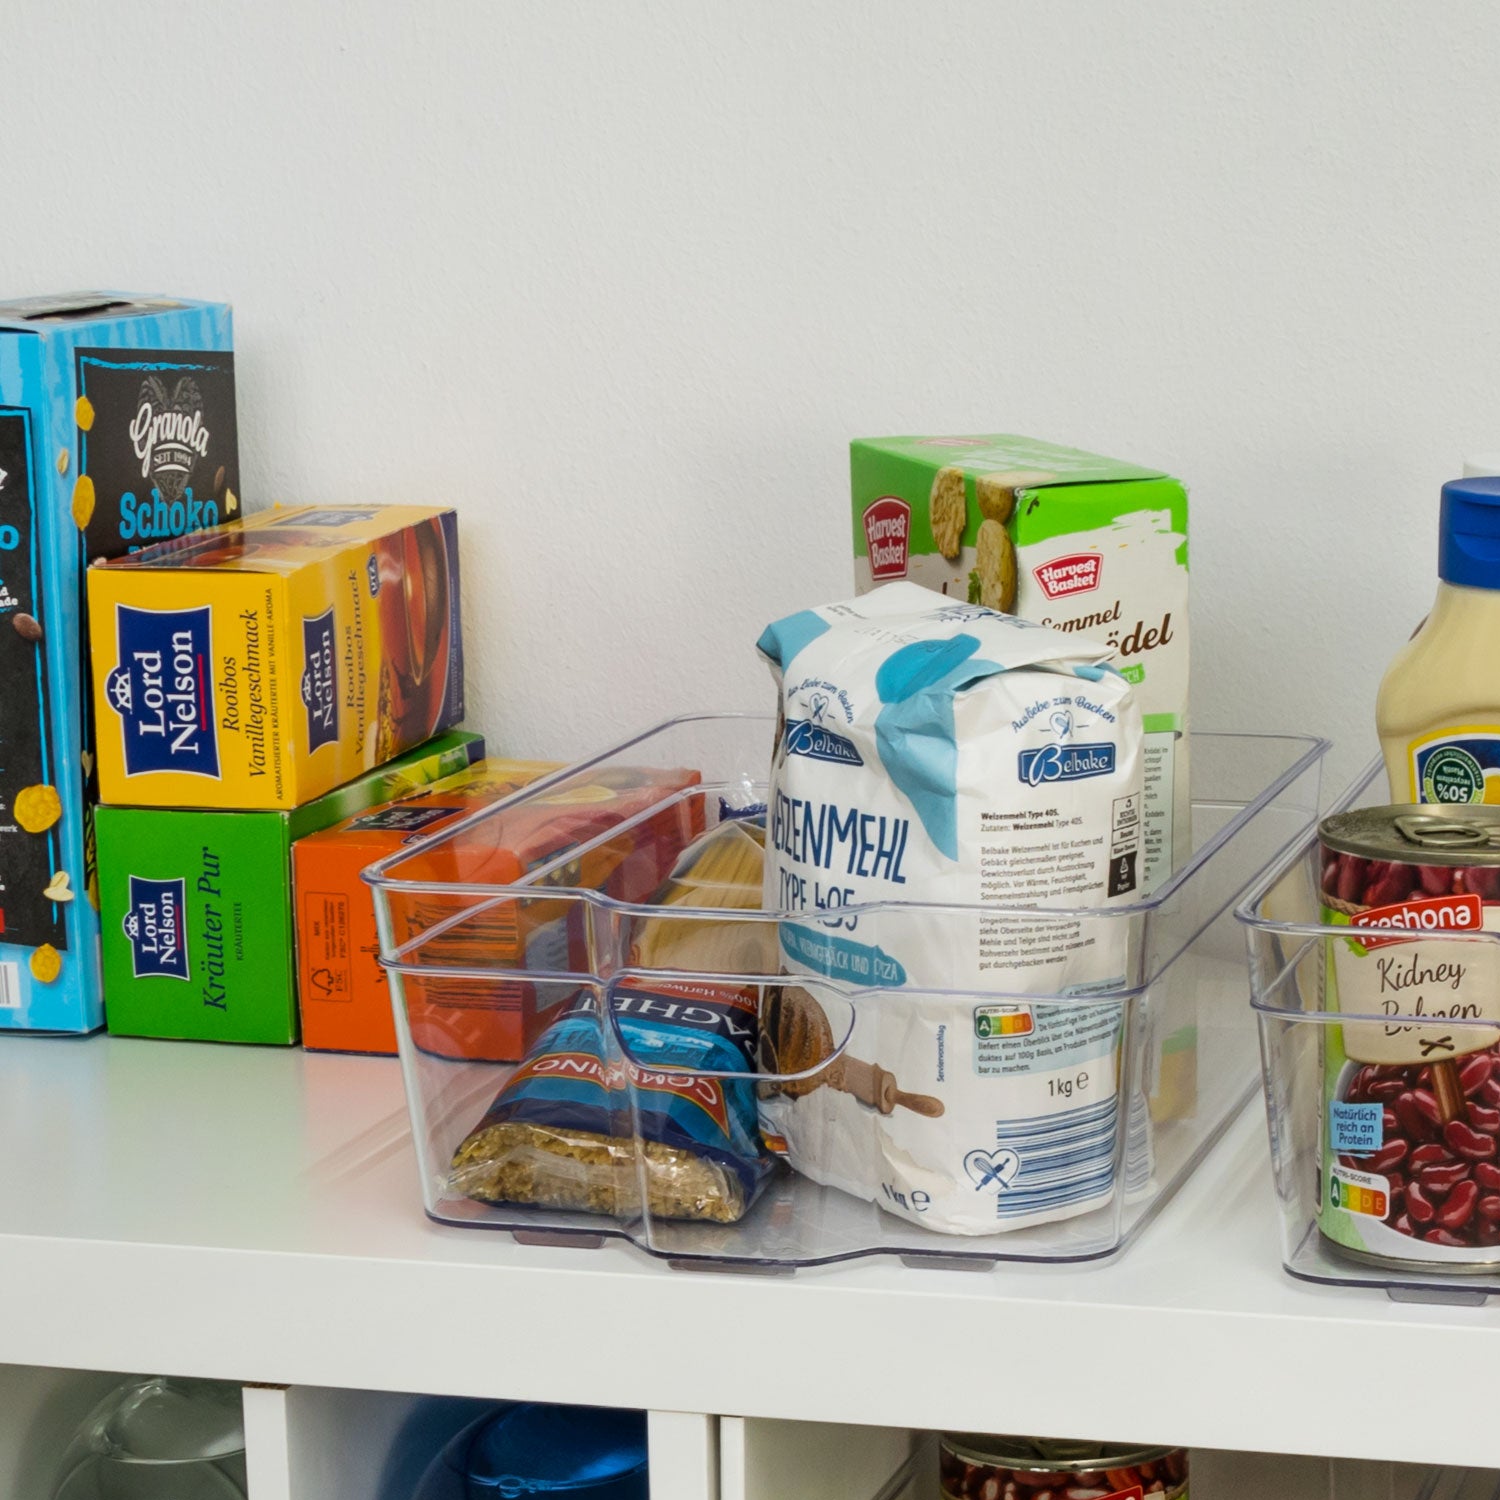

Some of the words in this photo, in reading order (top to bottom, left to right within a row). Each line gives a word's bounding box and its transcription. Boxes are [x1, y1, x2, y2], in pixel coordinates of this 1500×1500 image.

[129, 402, 209, 478] Granola
[154, 451, 171, 466] SEIT
[173, 450, 193, 468] 1994
[119, 488, 219, 540] Schoko
[868, 513, 906, 540] Harvest
[871, 542, 905, 567] Basket
[1042, 558, 1097, 582] Harvest
[1048, 573, 1096, 595] Basket
[264, 588, 277, 659] VANILLE-AROMA
[269, 660, 278, 676] MIT
[310, 650, 323, 721] Lord
[321, 629, 335, 731] Nelson
[344, 624, 357, 709] Rooibos
[348, 569, 366, 756] Vanillegeschmack
[139, 650, 165, 737] Lord
[170, 629, 200, 756] Nelson
[219, 656, 241, 733] Rooibos
[239, 608, 267, 778] Vanillegeschmack
[1052, 696, 1073, 706] zum
[1074, 695, 1117, 724] Backen
[1028, 742, 1109, 788] Belbake
[980, 811, 1027, 822] Weizenmehl
[1027, 809, 1044, 820] Type
[1436, 782, 1468, 803] 50%
[771, 787, 909, 885] EIZENMEHL
[1012, 821, 1055, 832] Weizenmehl
[1055, 818, 1070, 828] Type
[197, 845, 222, 898] Pur
[142, 902, 158, 955] Lord
[159, 890, 177, 965] Nelson
[979, 937, 1002, 948] Mehle
[1003, 936, 1017, 946] und
[201, 902, 229, 1012] Kräuter
[979, 961, 992, 972] gut
[1376, 952, 1467, 994] Kidney
[936, 1024, 947, 1083] Serviervorschlag
[978, 1065, 991, 1074] bar
[991, 1065, 1001, 1074] zu
[1332, 1107, 1377, 1124] Natürlich
[1336, 1121, 1358, 1135] reich
[1360, 1122, 1375, 1134] an
[1338, 1132, 1374, 1146] Protein
